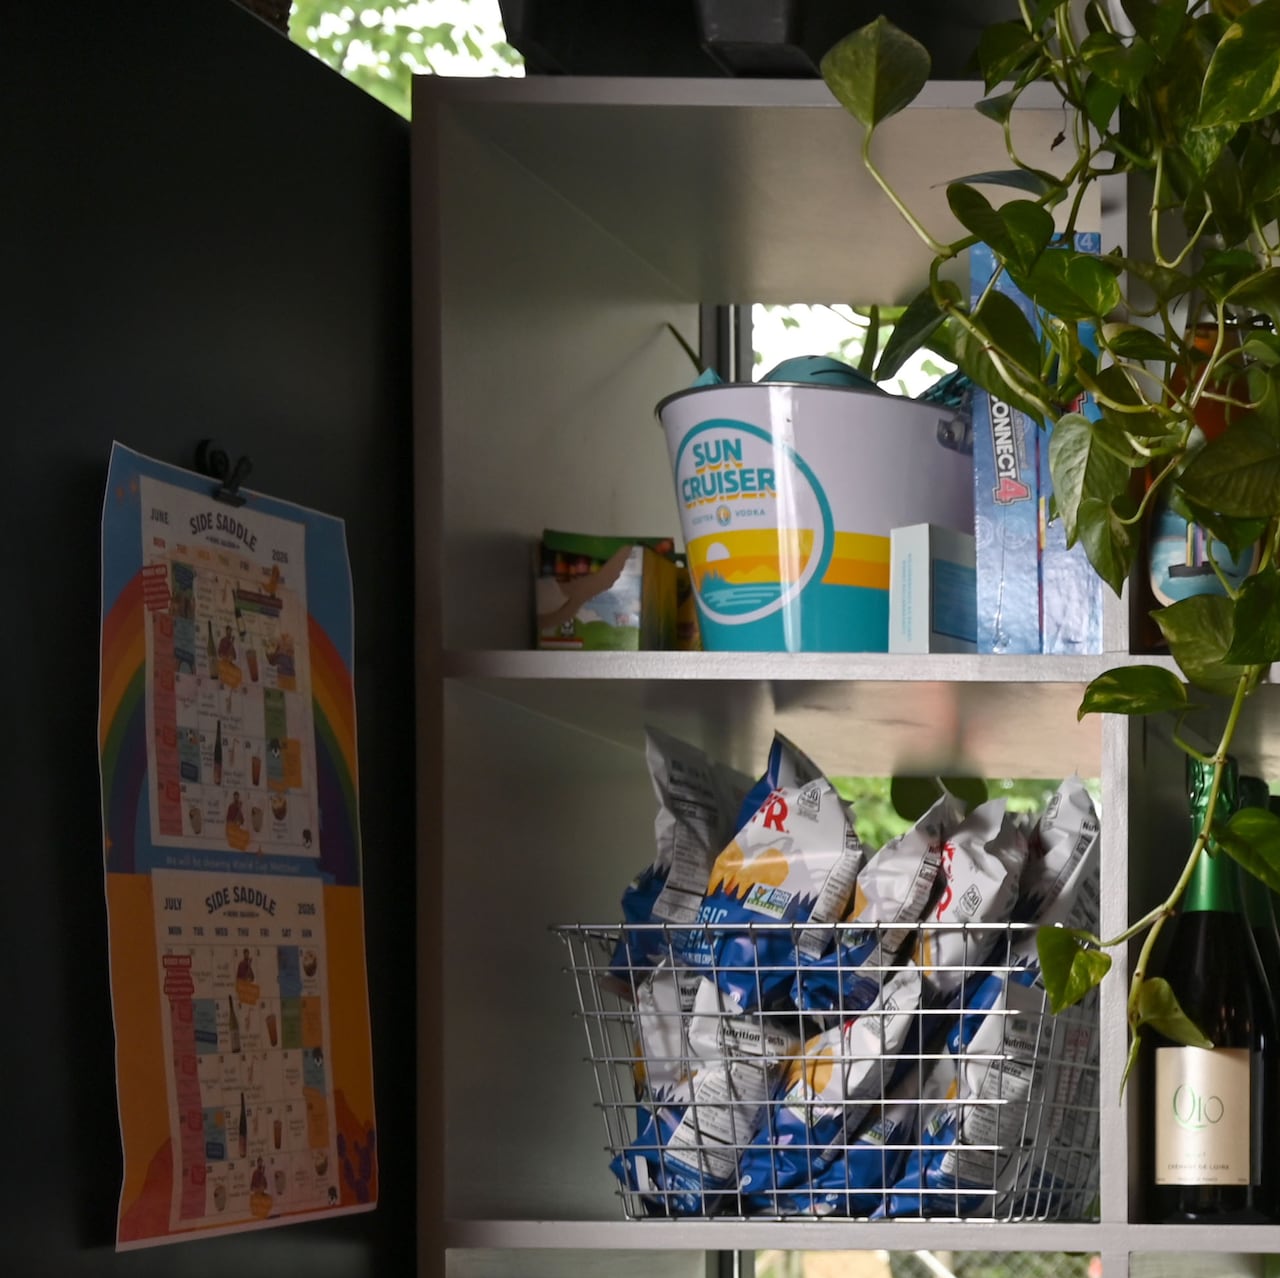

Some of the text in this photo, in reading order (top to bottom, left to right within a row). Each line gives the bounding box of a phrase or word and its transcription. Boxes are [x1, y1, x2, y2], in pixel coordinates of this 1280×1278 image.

[991, 395, 1016, 479] ONNECT
[692, 438, 743, 472] SUN
[681, 468, 777, 504] CRUISER
[993, 478, 1031, 504] 4
[150, 508, 169, 525] JUNE
[189, 511, 213, 535] SIDE
[215, 511, 258, 552] SADDLE
[163, 897, 183, 911] JULY
[204, 887, 230, 915] SIDE
[233, 885, 277, 917] SADDLE
[168, 926, 183, 936] MON
[193, 926, 205, 937] TUE
[214, 926, 229, 937] WED
[237, 927, 250, 937] THU
[259, 927, 270, 937] FRI
[281, 928, 292, 938] SAT
[764, 1033, 786, 1047] acts
